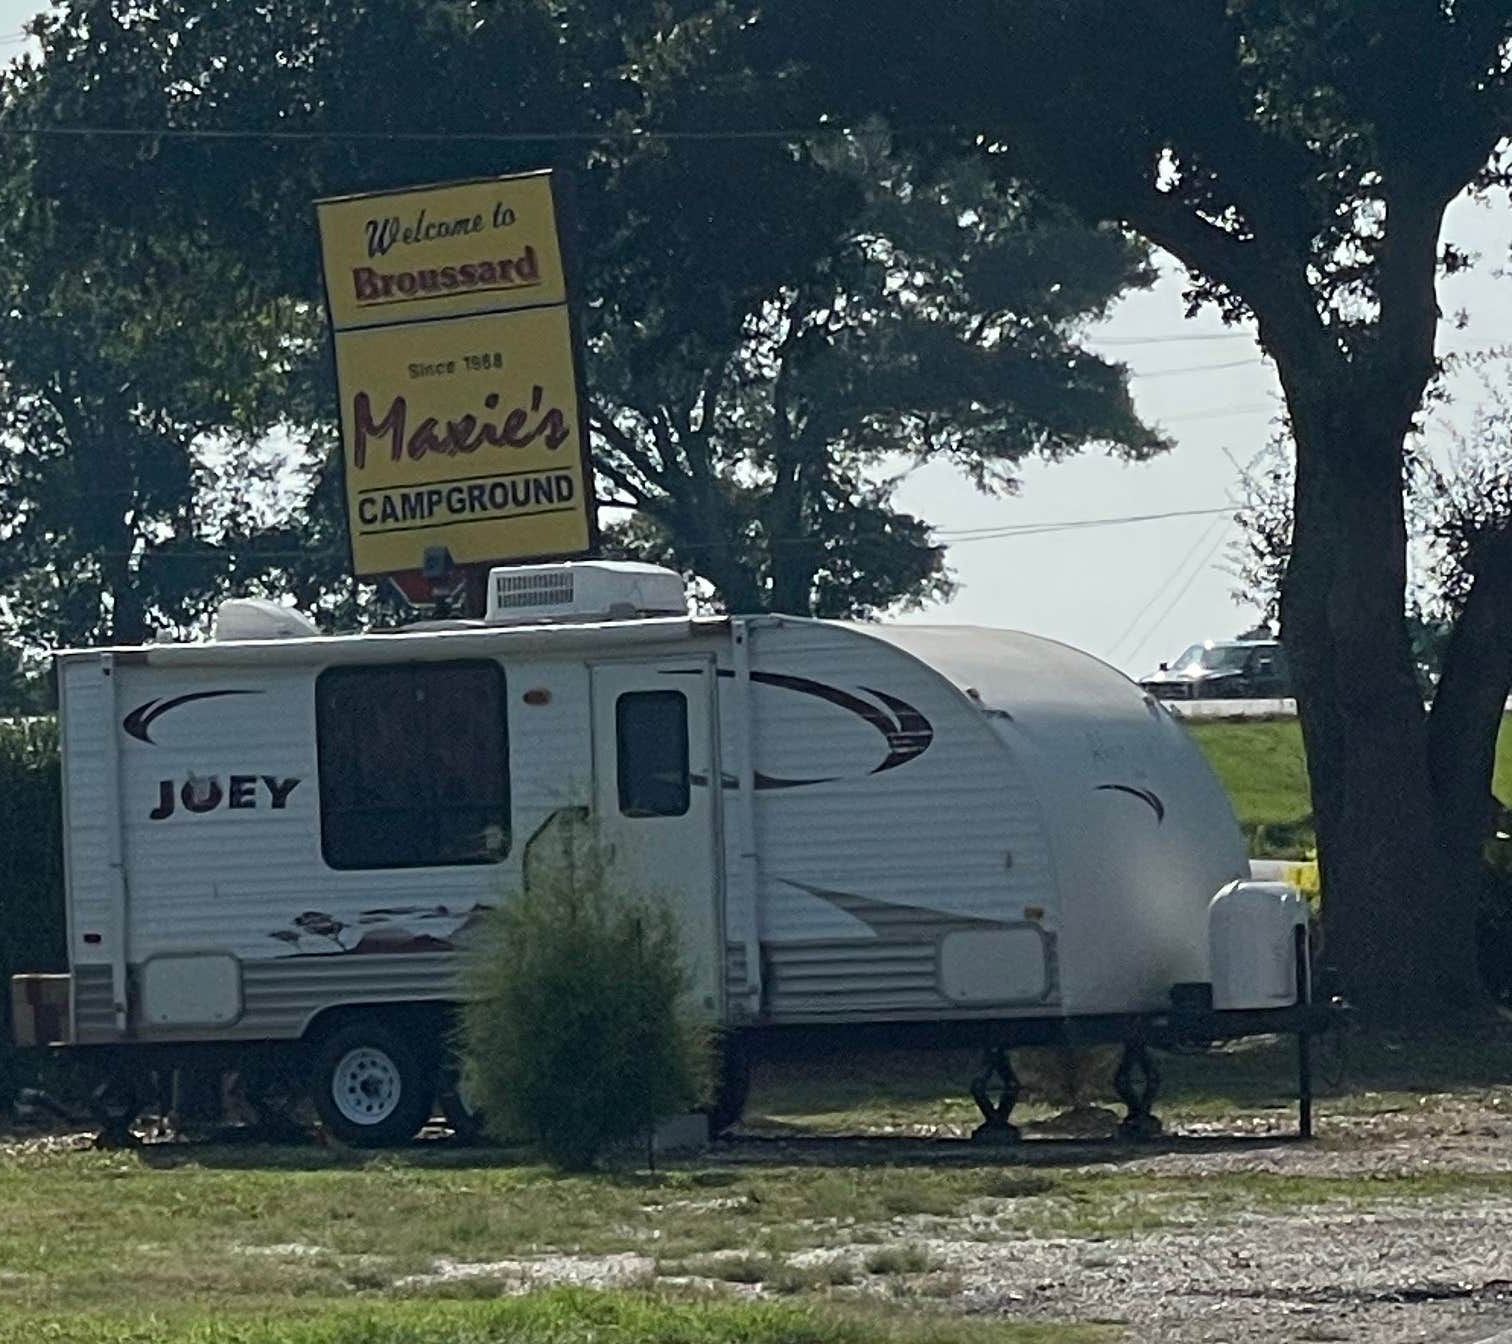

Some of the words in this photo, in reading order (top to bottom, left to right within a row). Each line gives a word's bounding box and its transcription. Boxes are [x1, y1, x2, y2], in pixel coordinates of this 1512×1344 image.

[366, 209, 484, 258] Welcome
[492, 201, 517, 231] to
[352, 246, 540, 301] Broussard
[407, 360, 456, 380] Since
[353, 385, 570, 470] Maxie's
[358, 475, 575, 526] CAMPGROUND
[149, 773, 302, 821] JOEY
